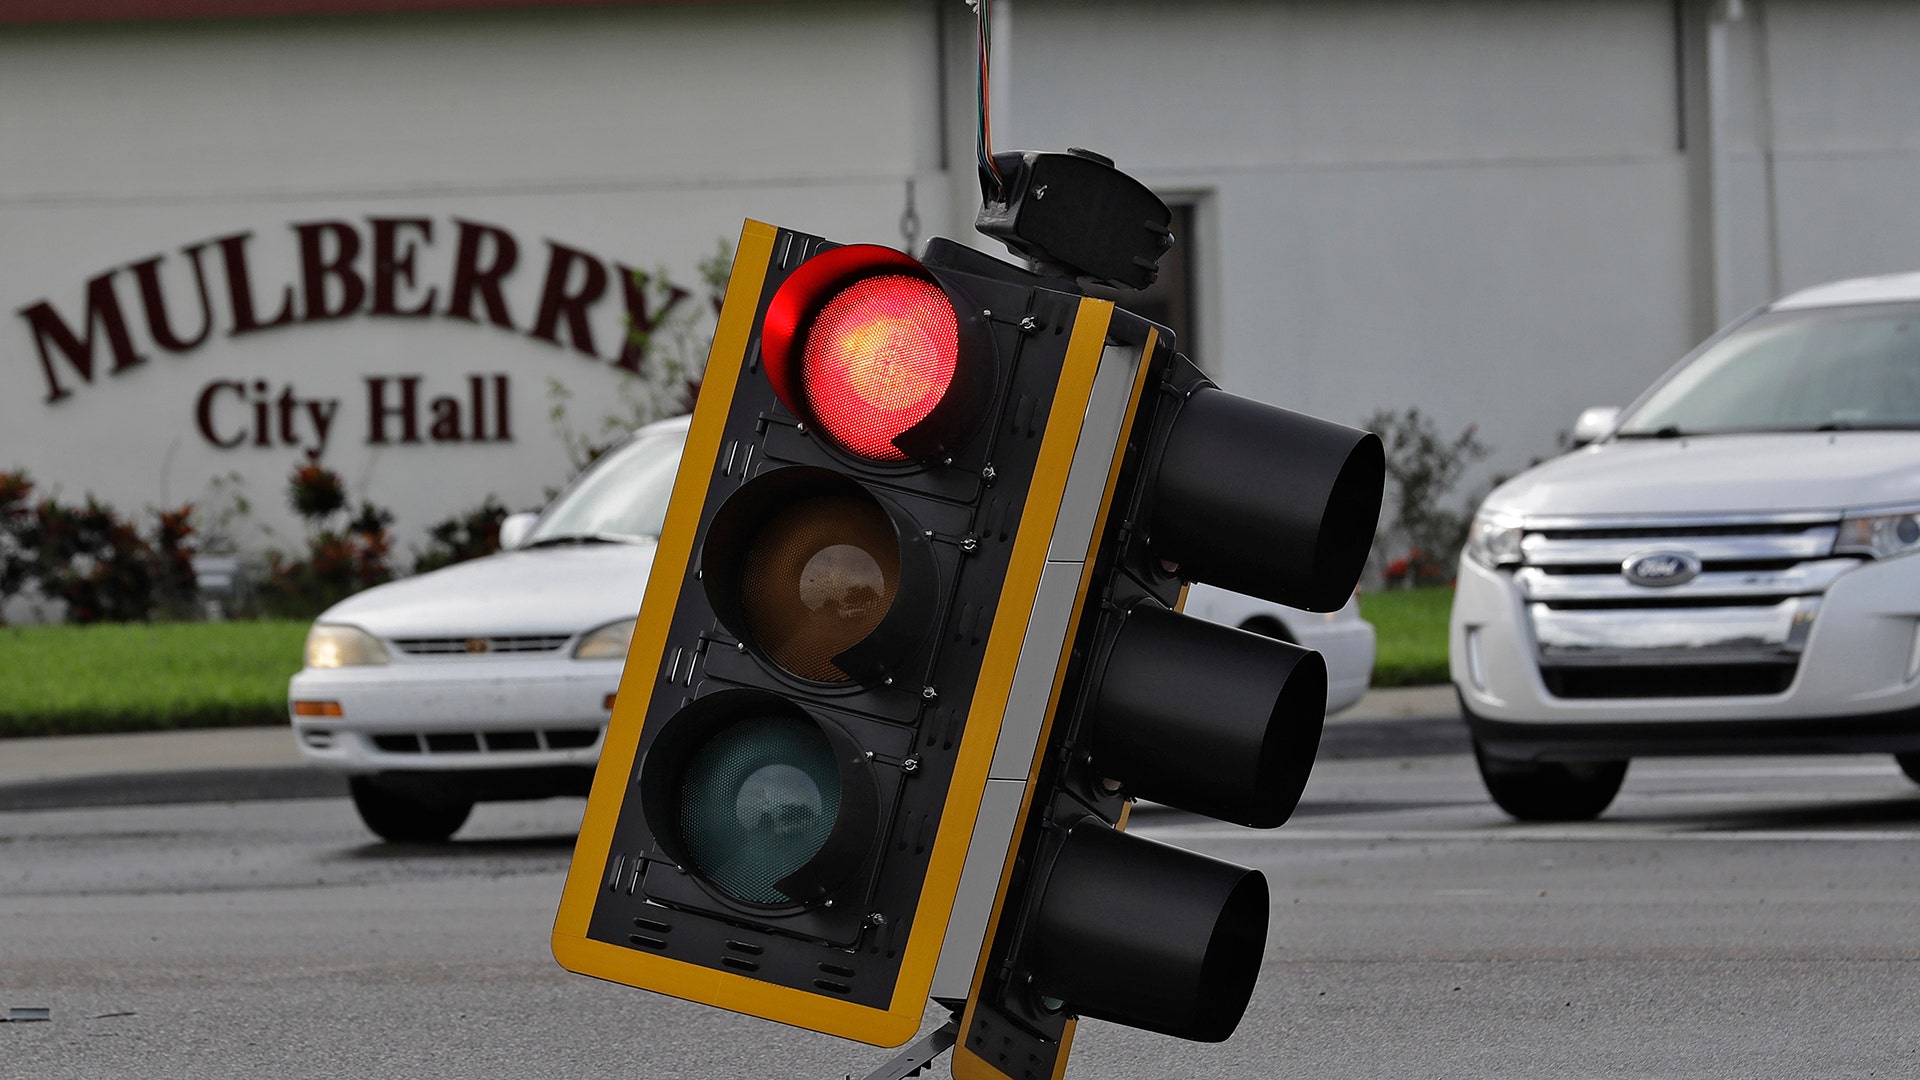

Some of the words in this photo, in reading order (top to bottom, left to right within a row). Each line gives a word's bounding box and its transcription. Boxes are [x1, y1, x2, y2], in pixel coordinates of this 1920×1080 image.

[19, 216, 693, 404] MULBERRY
[195, 378, 340, 456] City
[363, 374, 513, 446] Hall
[1636, 557, 1682, 577] Ford
